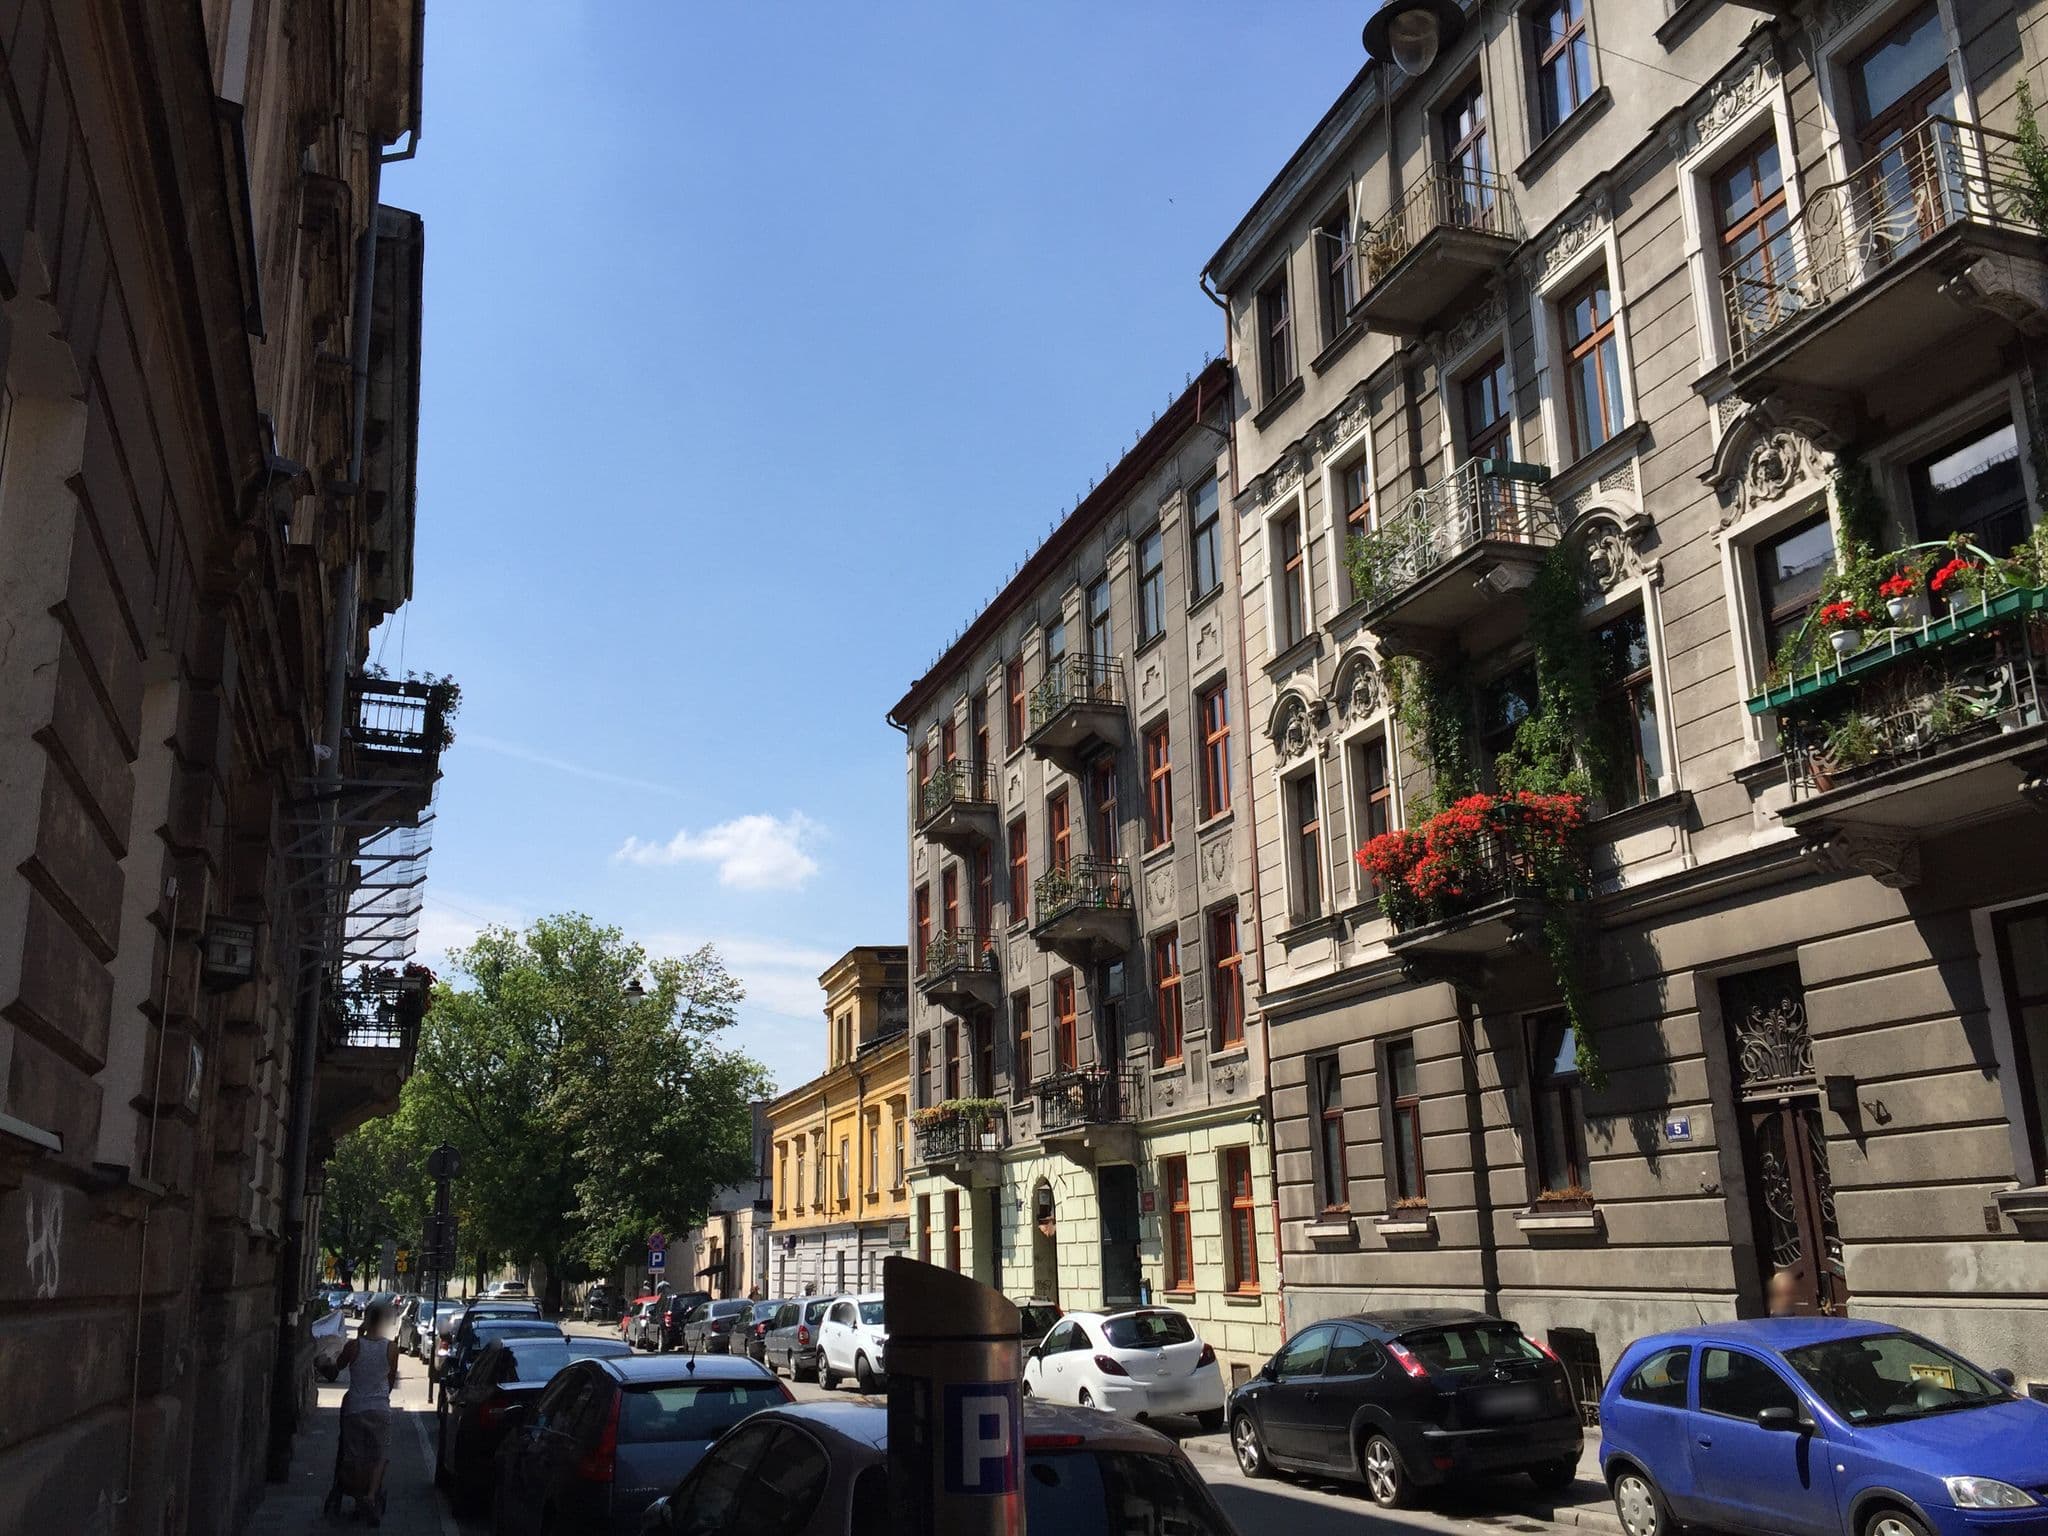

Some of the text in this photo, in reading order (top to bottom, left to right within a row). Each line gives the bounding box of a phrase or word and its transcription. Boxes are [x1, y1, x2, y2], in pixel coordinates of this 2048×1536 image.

[1673, 1123, 1682, 1134] 5
[652, 1252, 662, 1266] P
[962, 1396, 1010, 1486] P
